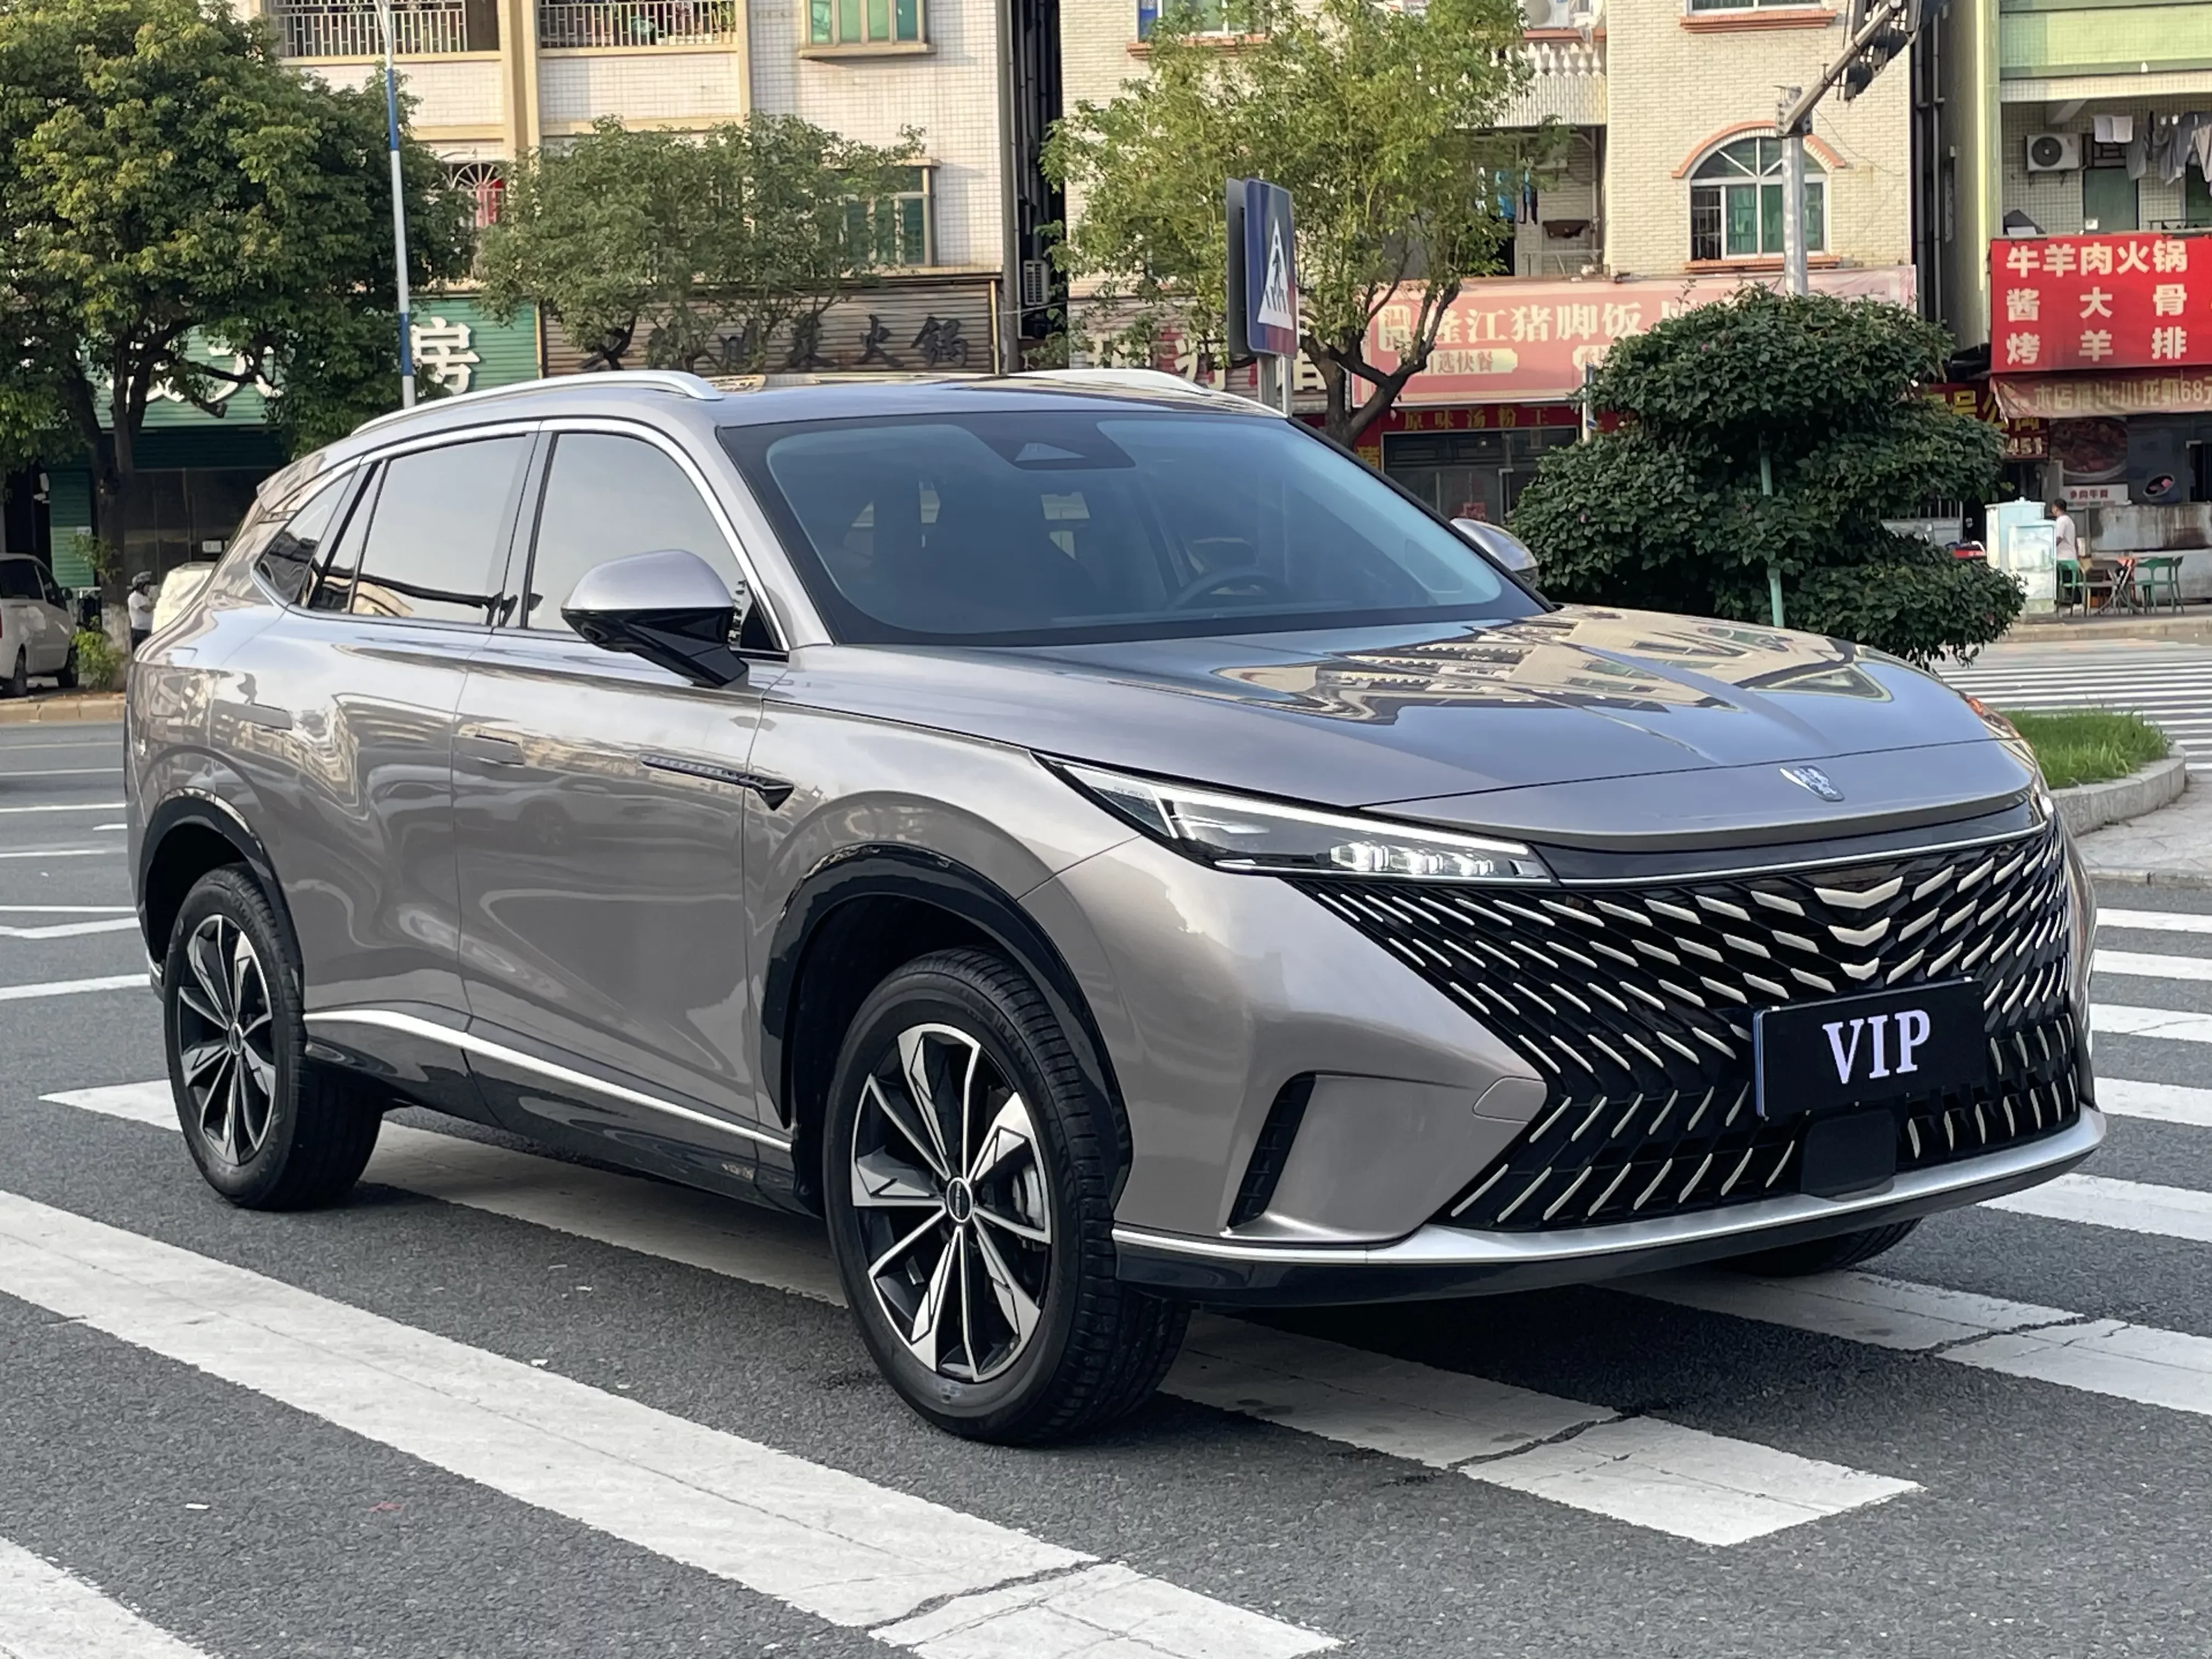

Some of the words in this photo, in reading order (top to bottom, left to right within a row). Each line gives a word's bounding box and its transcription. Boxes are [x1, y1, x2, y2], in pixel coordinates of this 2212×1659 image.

[2006, 240, 2187, 278] 牛羊肉火锅
[2006, 284, 2187, 322] 酱大骨
[1428, 350, 1493, 375] 选快餐
[2006, 327, 2187, 365] 烤羊排
[1821, 1009, 1931, 1085] VIP
